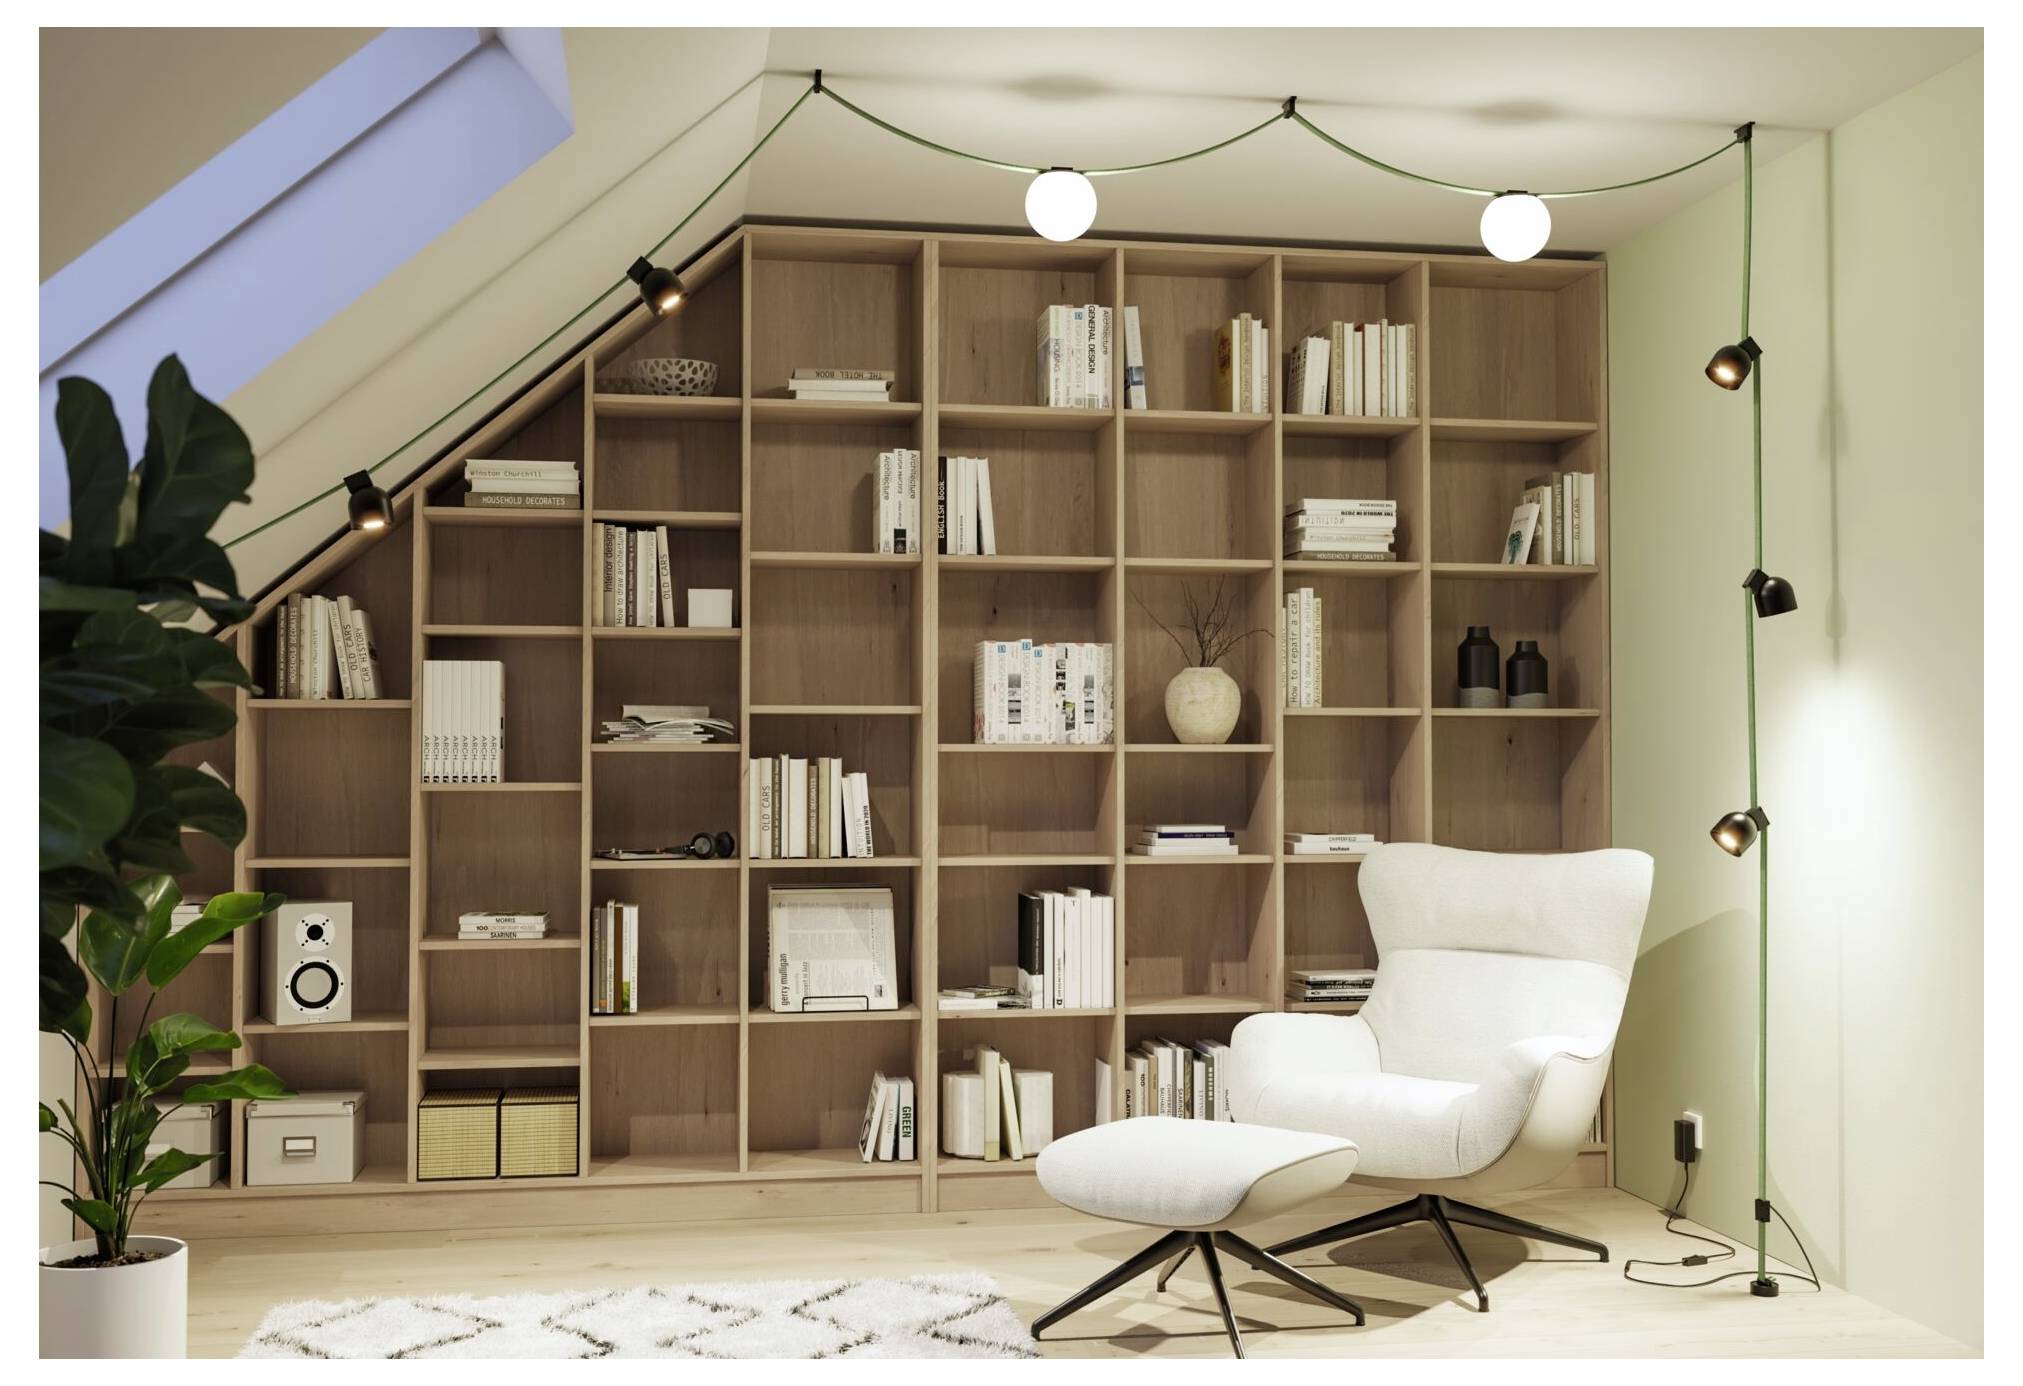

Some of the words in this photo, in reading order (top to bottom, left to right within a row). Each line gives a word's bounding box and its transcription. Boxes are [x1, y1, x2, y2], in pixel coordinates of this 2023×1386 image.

[815, 370, 835, 378] BOOK
[840, 370, 864, 379] HOTEL
[870, 371, 882, 380] THE
[504, 470, 542, 478] Churchill
[883, 455, 892, 501] Architecture
[909, 453, 918, 499] Architecture
[482, 495, 522, 505] HOUSEHOLD
[525, 497, 566, 506] DECORATES
[604, 528, 615, 558] design
[616, 530, 624, 575] architecture
[660, 553, 669, 577] CARS
[1317, 552, 1350, 560] HOUSEHOLD
[604, 561, 613, 592] Interior
[663, 582, 671, 600] OLD
[616, 598, 623, 606] to
[289, 607, 297, 644] DECORATES
[616, 608, 624, 624] How
[344, 624, 354, 647] CARS
[355, 627, 368, 662] HISTORY
[1290, 631, 1300, 664] repair
[348, 653, 358, 671] OLD
[362, 665, 371, 682] CAR
[1290, 669, 1298, 680] to
[761, 785, 770, 808] CARS
[762, 814, 770, 831] OLD
[779, 953, 789, 985] mulligan
[780, 986, 790, 1006] gerry
[902, 1106, 912, 1138] GREEN
